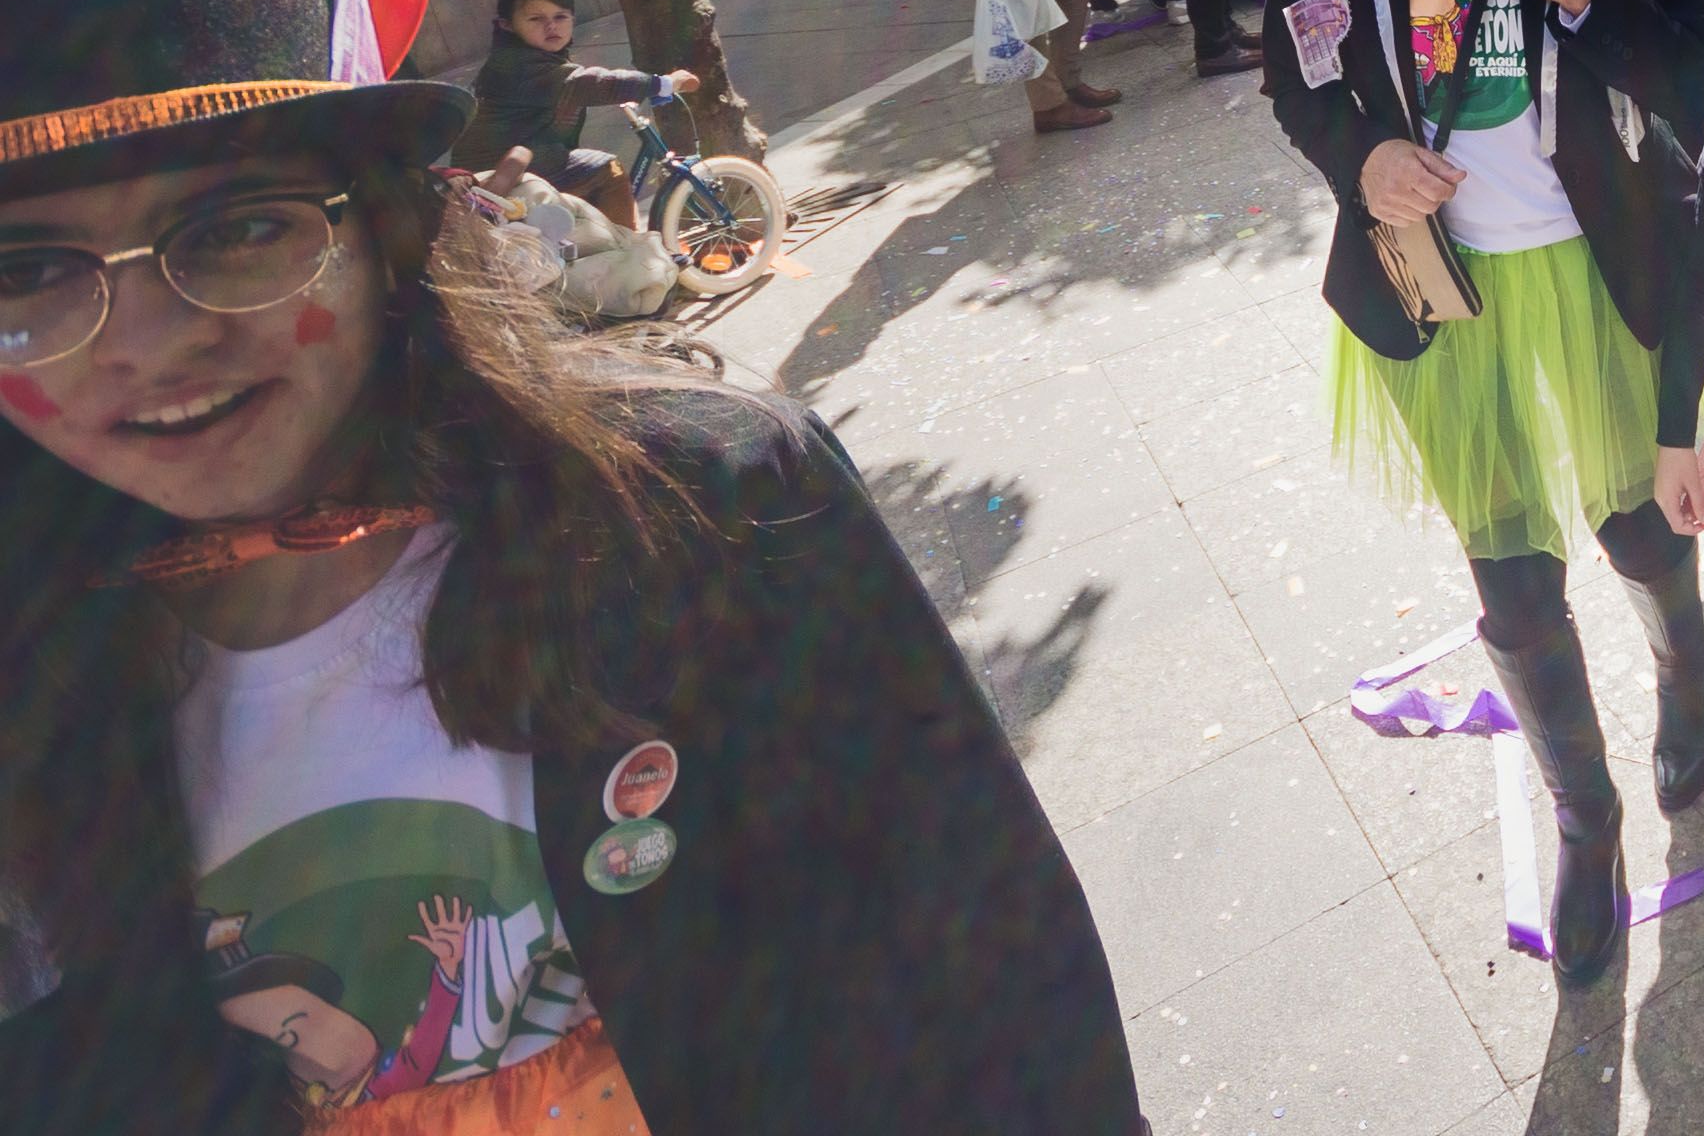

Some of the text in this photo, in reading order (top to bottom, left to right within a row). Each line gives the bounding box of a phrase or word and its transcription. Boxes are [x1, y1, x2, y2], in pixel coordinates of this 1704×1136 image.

[1469, 56, 1486, 67] DE
[1487, 53, 1518, 67] AQUÍ
[1475, 67, 1528, 78] ETERNID
[621, 767, 669, 786] Juanelo
